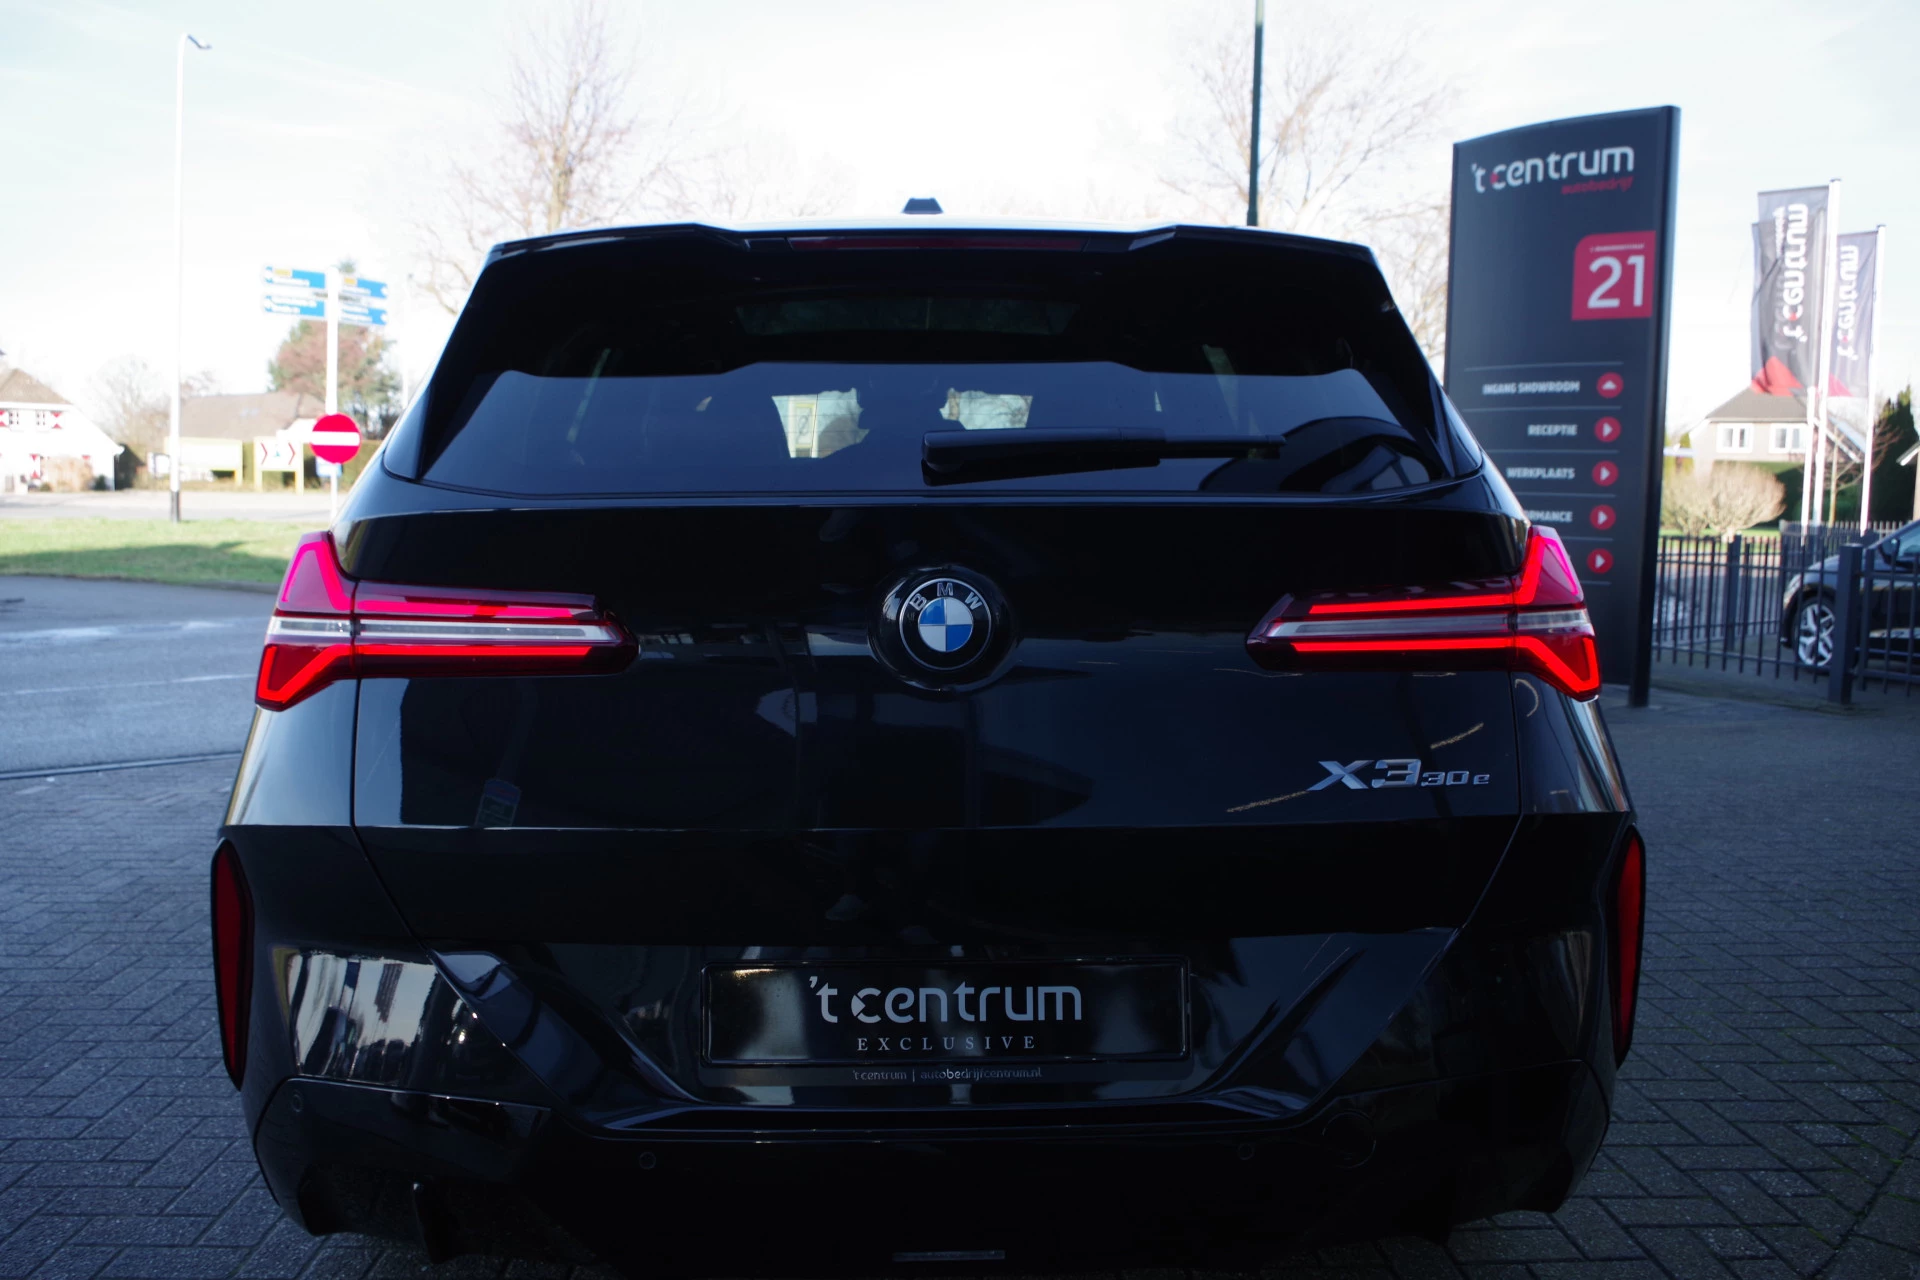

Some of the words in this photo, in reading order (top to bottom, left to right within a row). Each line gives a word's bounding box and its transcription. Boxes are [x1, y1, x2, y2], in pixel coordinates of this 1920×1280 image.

[1490, 146, 1635, 190] centrum
[1587, 254, 1645, 309] 21
[1482, 382, 1516, 395] INGANG
[1517, 380, 1580, 394] SHOWROOM
[1527, 424, 1578, 436] RECEPTIE
[1506, 467, 1576, 479] WERKPLAATS
[909, 582, 982, 611] BMW
[1306, 759, 1421, 791] X3
[809, 976, 838, 1023] 't
[851, 981, 1082, 1023] centrum
[857, 1035, 1035, 1051] EXCLUSIVE
[860, 1071, 907, 1081] centrum
